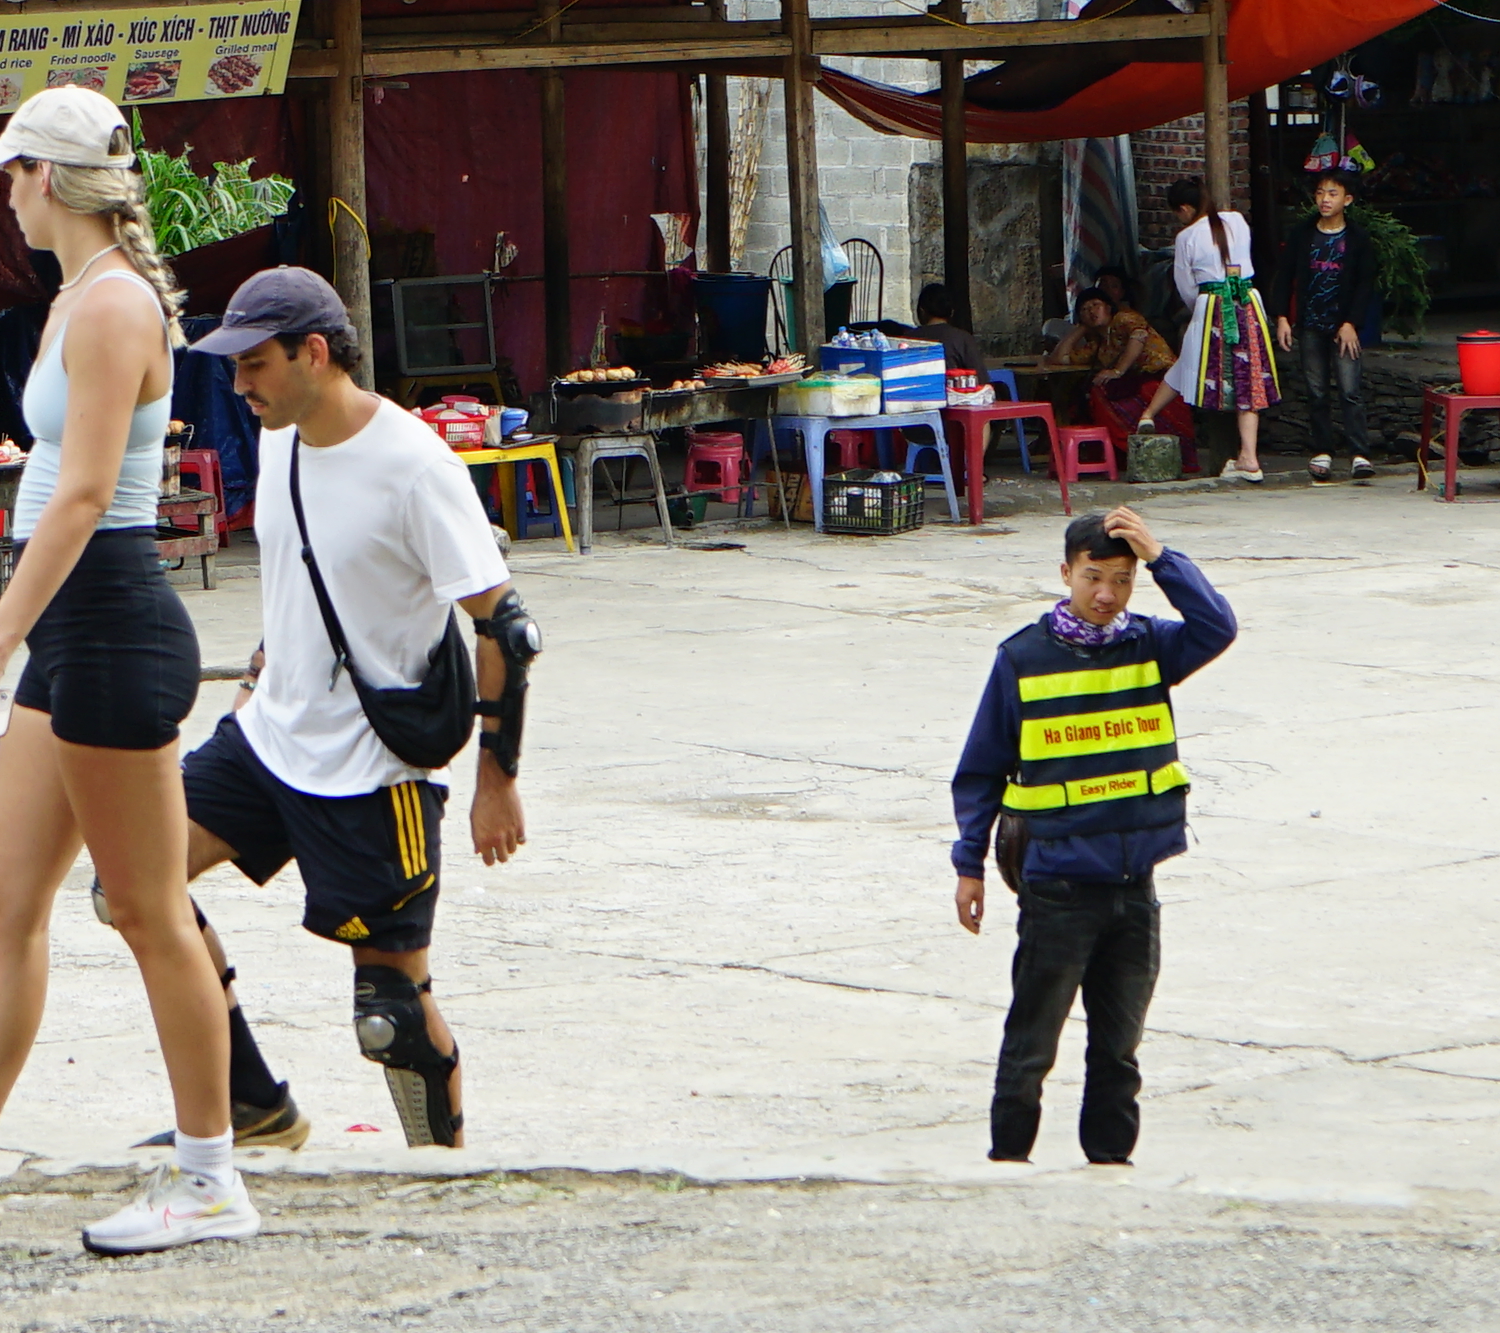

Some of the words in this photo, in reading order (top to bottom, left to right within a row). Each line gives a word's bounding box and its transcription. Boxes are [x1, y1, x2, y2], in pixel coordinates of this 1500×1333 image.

[8, 27, 49, 55] RANG
[62, 20, 83, 48] MÌ
[85, 19, 115, 47] XÀO
[127, 16, 157, 44] XÚC
[160, 14, 196, 43] XÍCH
[208, 15, 239, 44] THỊT
[240, 8, 291, 37] NƯỚNG
[134, 48, 179, 60] Sausage
[215, 44, 249, 56] Grilled
[251, 42, 278, 54] meat
[10, 57, 33, 69] rice
[50, 54, 78, 66] Fried
[80, 52, 116, 64] noodle
[1044, 728, 1061, 745] Ha
[1065, 724, 1100, 743] Giang
[1104, 718, 1133, 738] Epic
[1136, 715, 1161, 733] Tour
[1080, 784, 1106, 798] Easy
[1109, 779, 1137, 792] Rider
